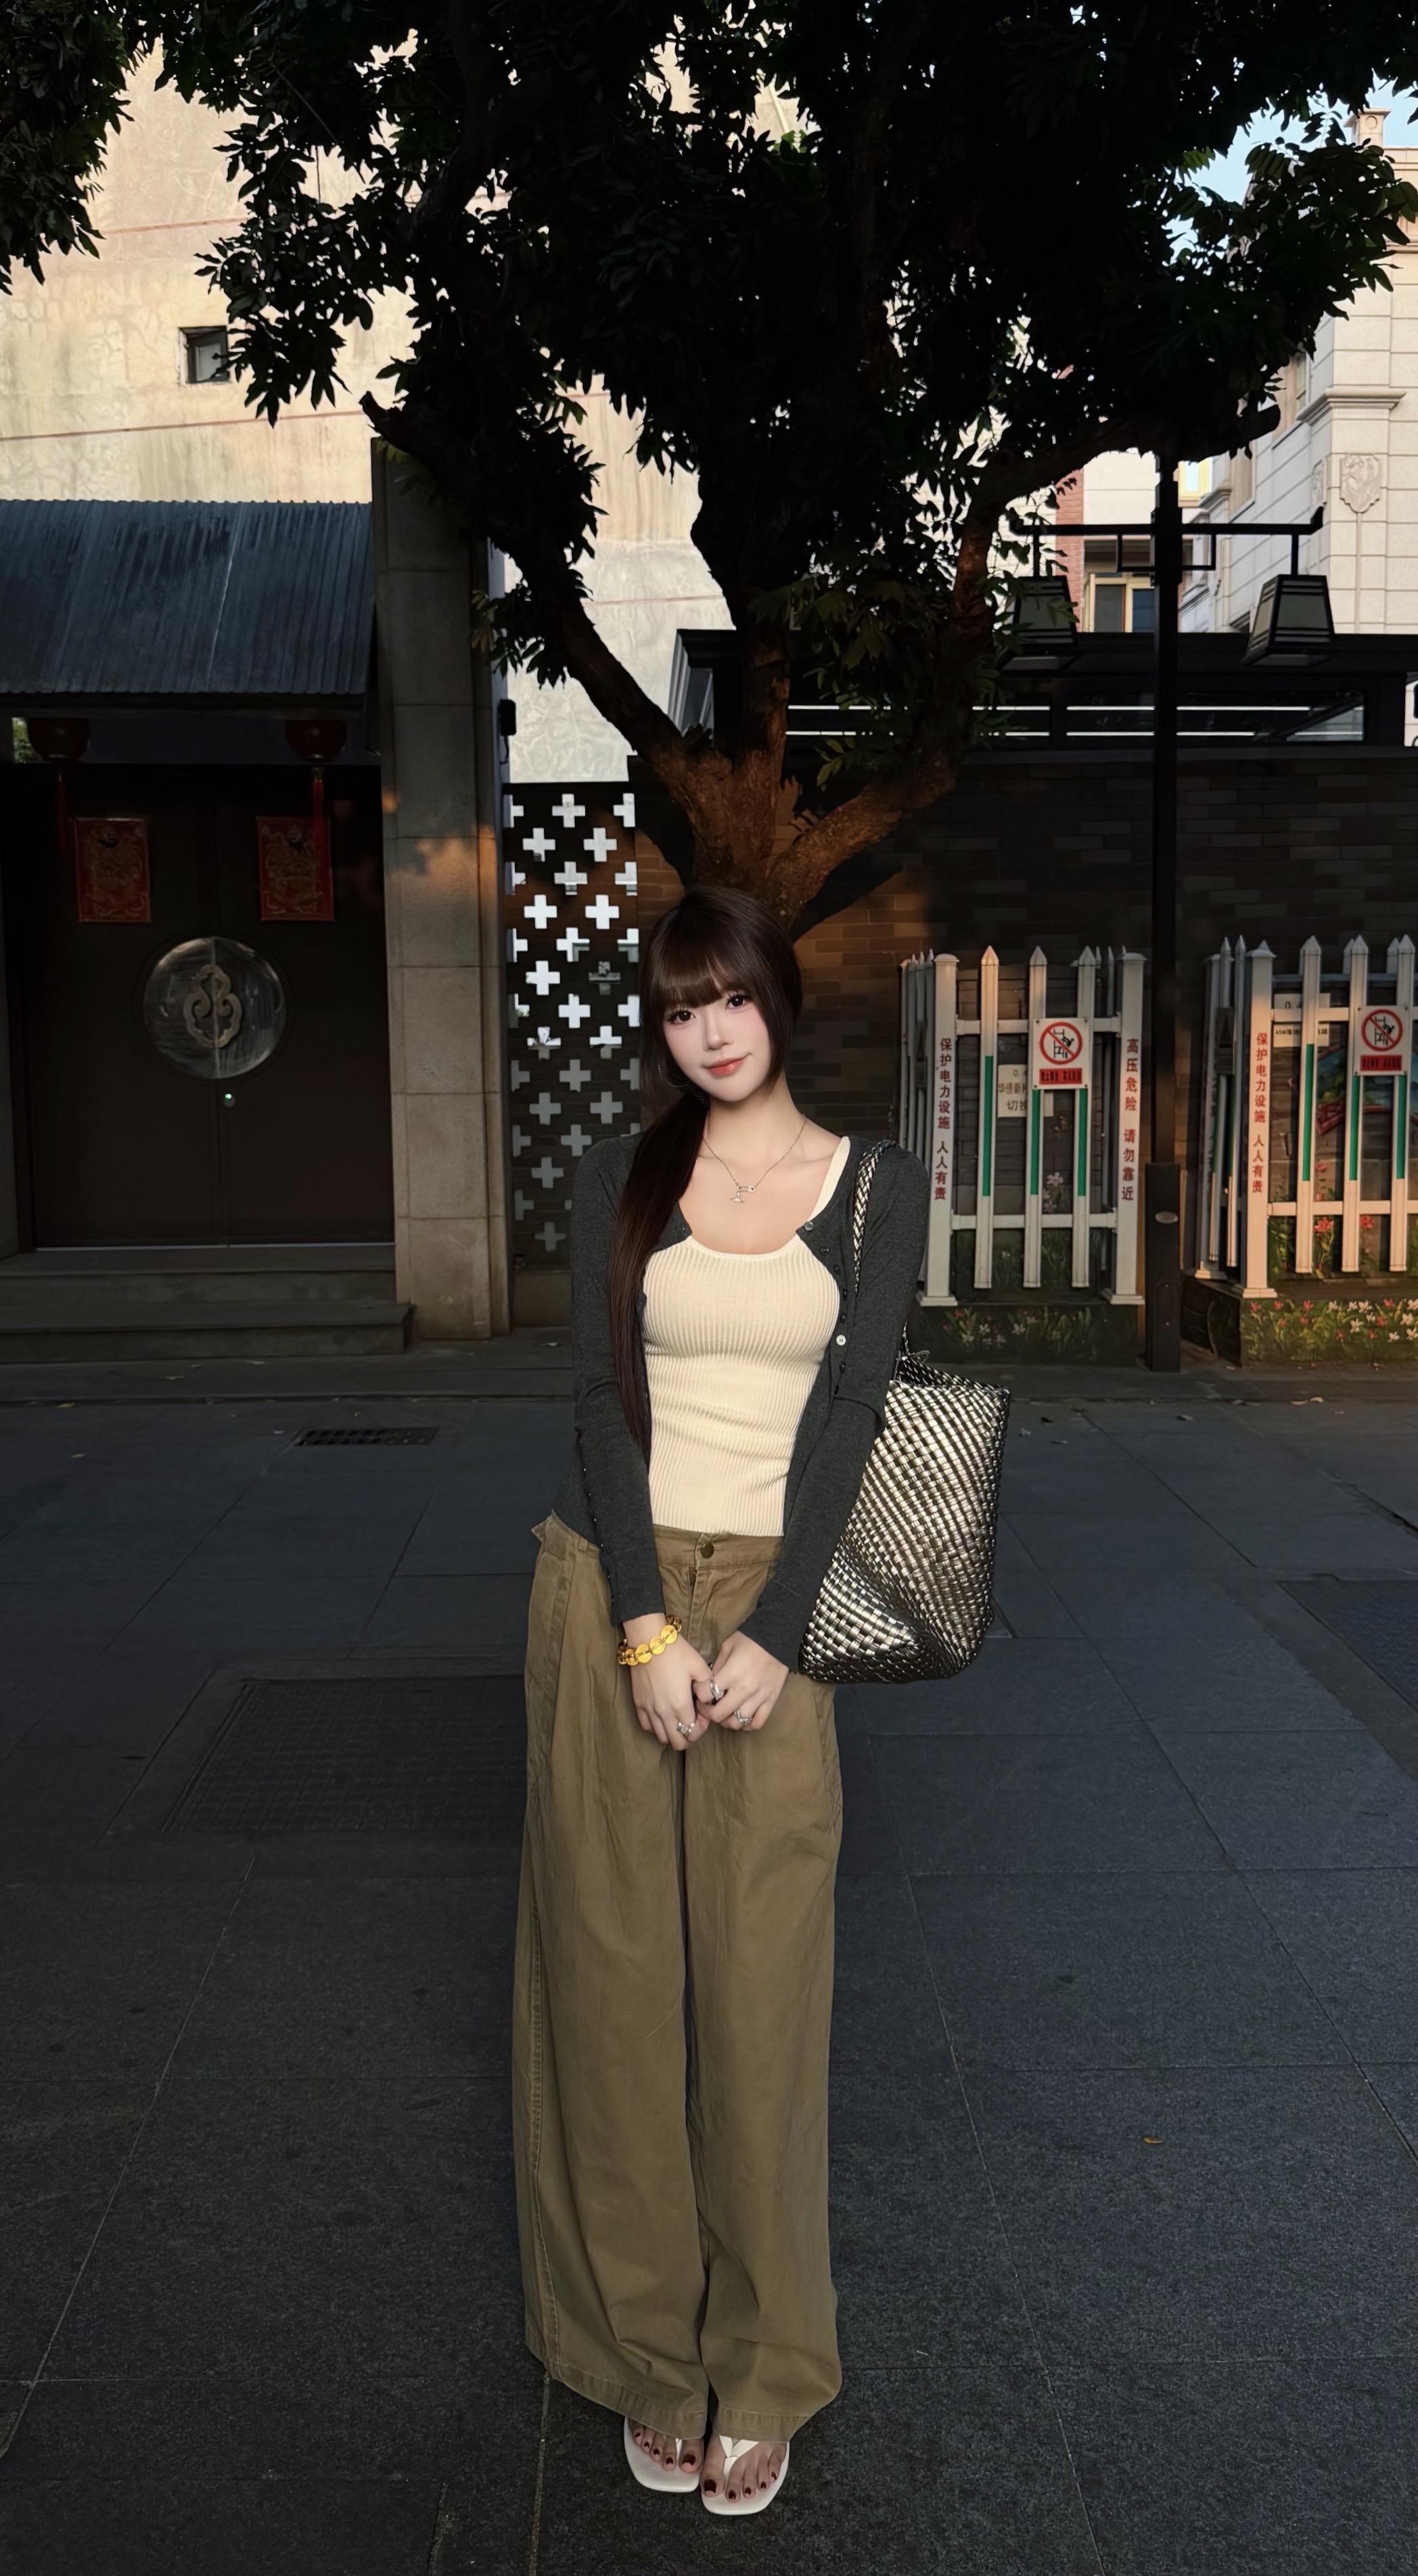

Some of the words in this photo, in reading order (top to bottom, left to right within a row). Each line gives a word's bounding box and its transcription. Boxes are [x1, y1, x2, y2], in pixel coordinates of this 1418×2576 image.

[938, 1038, 952, 1130] 保护电力设施
[1125, 1038, 1139, 1111] 高压危险
[1254, 1032, 1268, 1123] 保护电力设施
[934, 1141, 948, 1200] 人人有责
[1122, 1128, 1136, 1201] 请勿靠近
[1252, 1134, 1264, 1193] 人人有责
